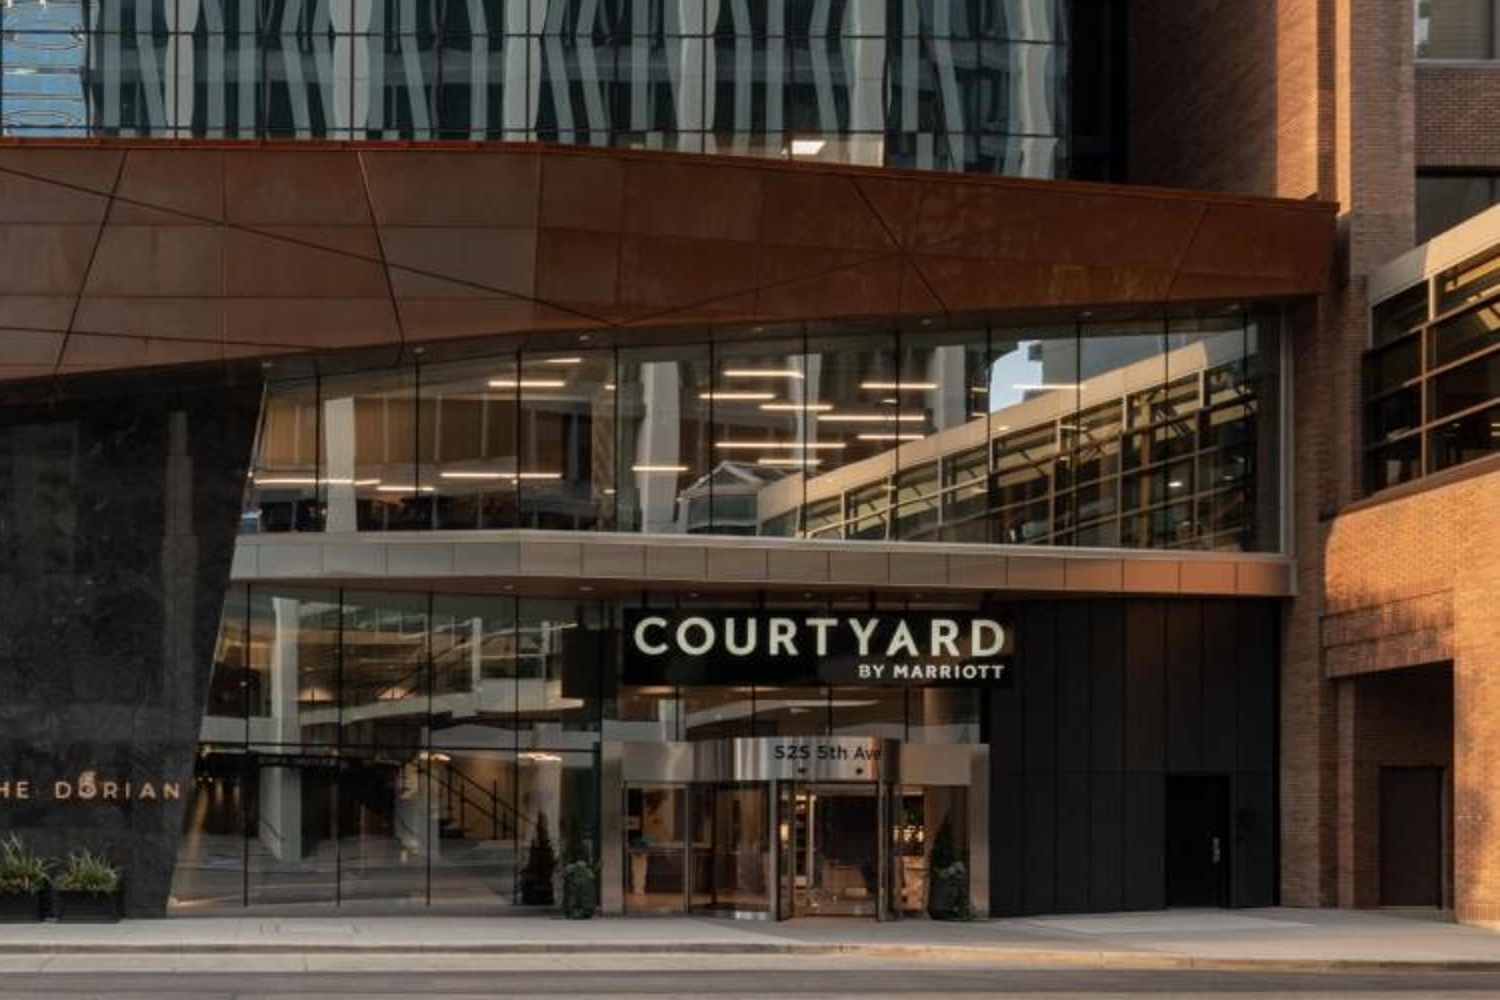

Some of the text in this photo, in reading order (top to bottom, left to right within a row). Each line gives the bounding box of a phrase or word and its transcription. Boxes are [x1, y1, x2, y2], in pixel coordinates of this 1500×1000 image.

[633, 616, 1006, 657] COURTYARD
[858, 664, 1005, 680] BY MARRIOTT
[774, 745, 811, 760] 525
[816, 745, 848, 760] 5th
[54, 777, 181, 799] DORIAN
